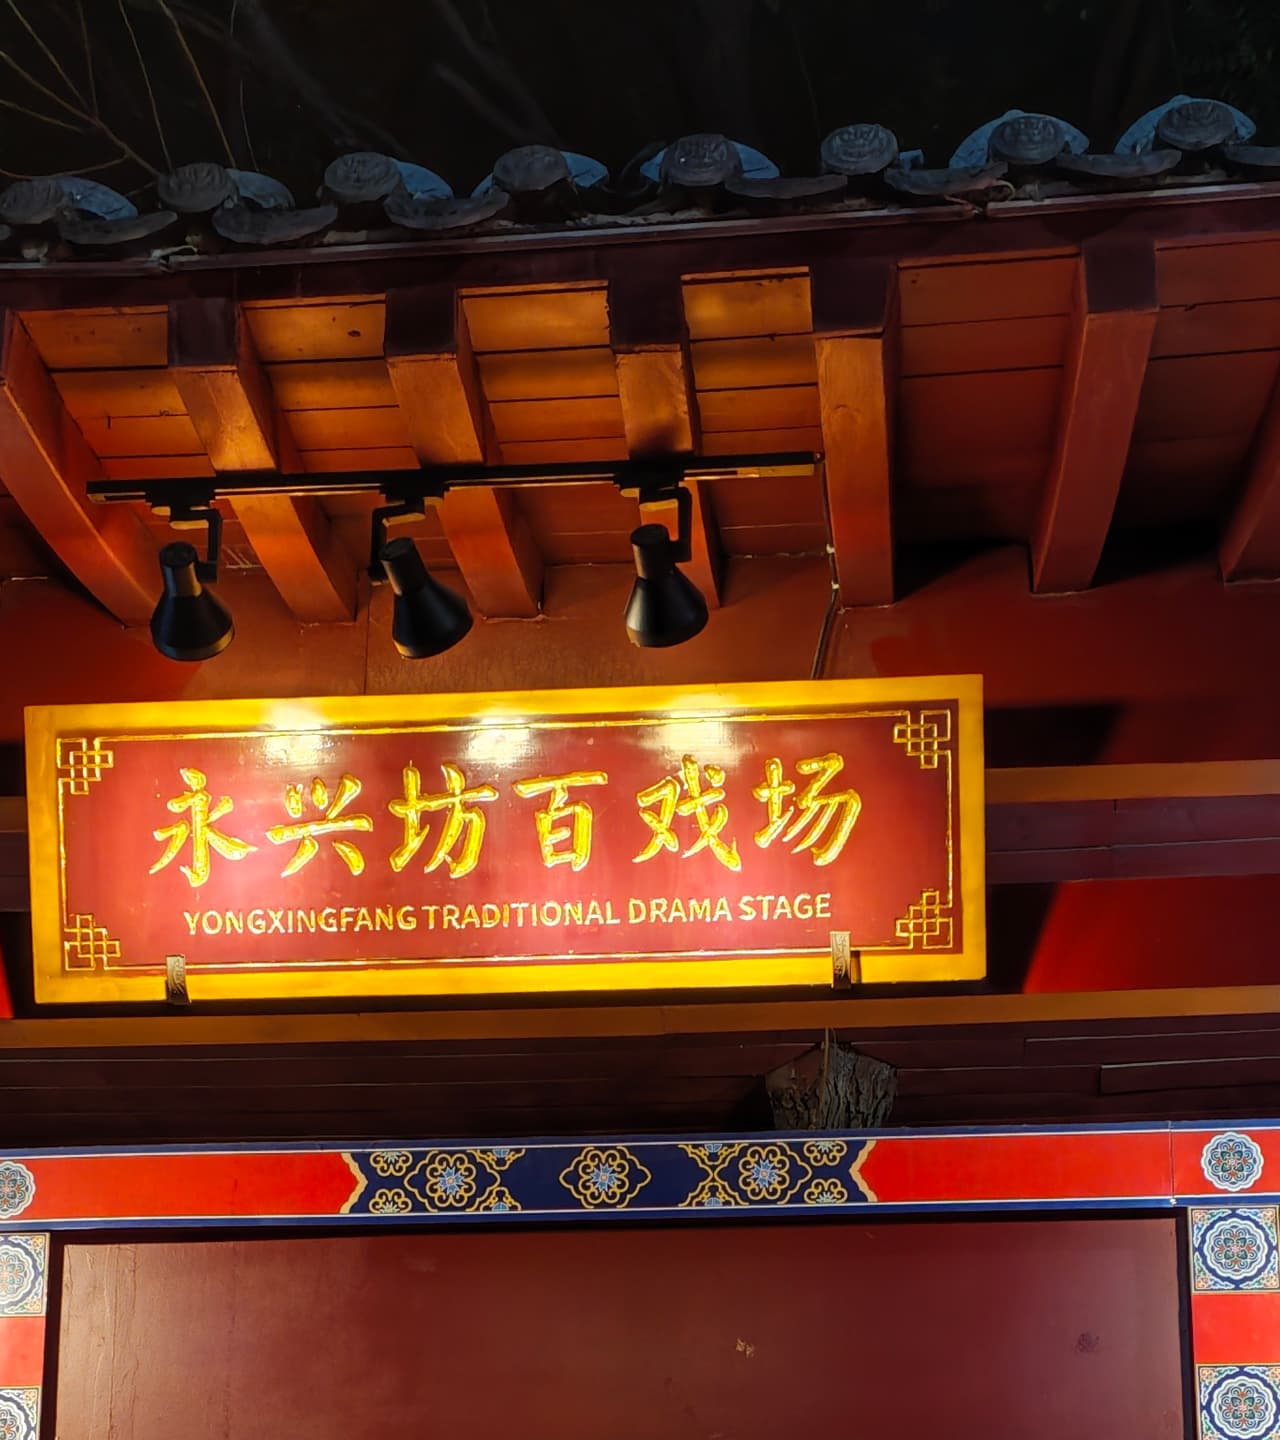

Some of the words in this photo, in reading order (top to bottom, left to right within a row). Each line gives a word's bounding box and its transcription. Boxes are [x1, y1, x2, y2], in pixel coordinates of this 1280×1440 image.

[149, 752, 862, 887] 永兴坊百戏场
[183, 904, 417, 935] YONGXINGFANG
[422, 900, 620, 930] TRADITIONAL
[628, 896, 733, 924] DRAMA
[739, 893, 832, 921] STAGE
